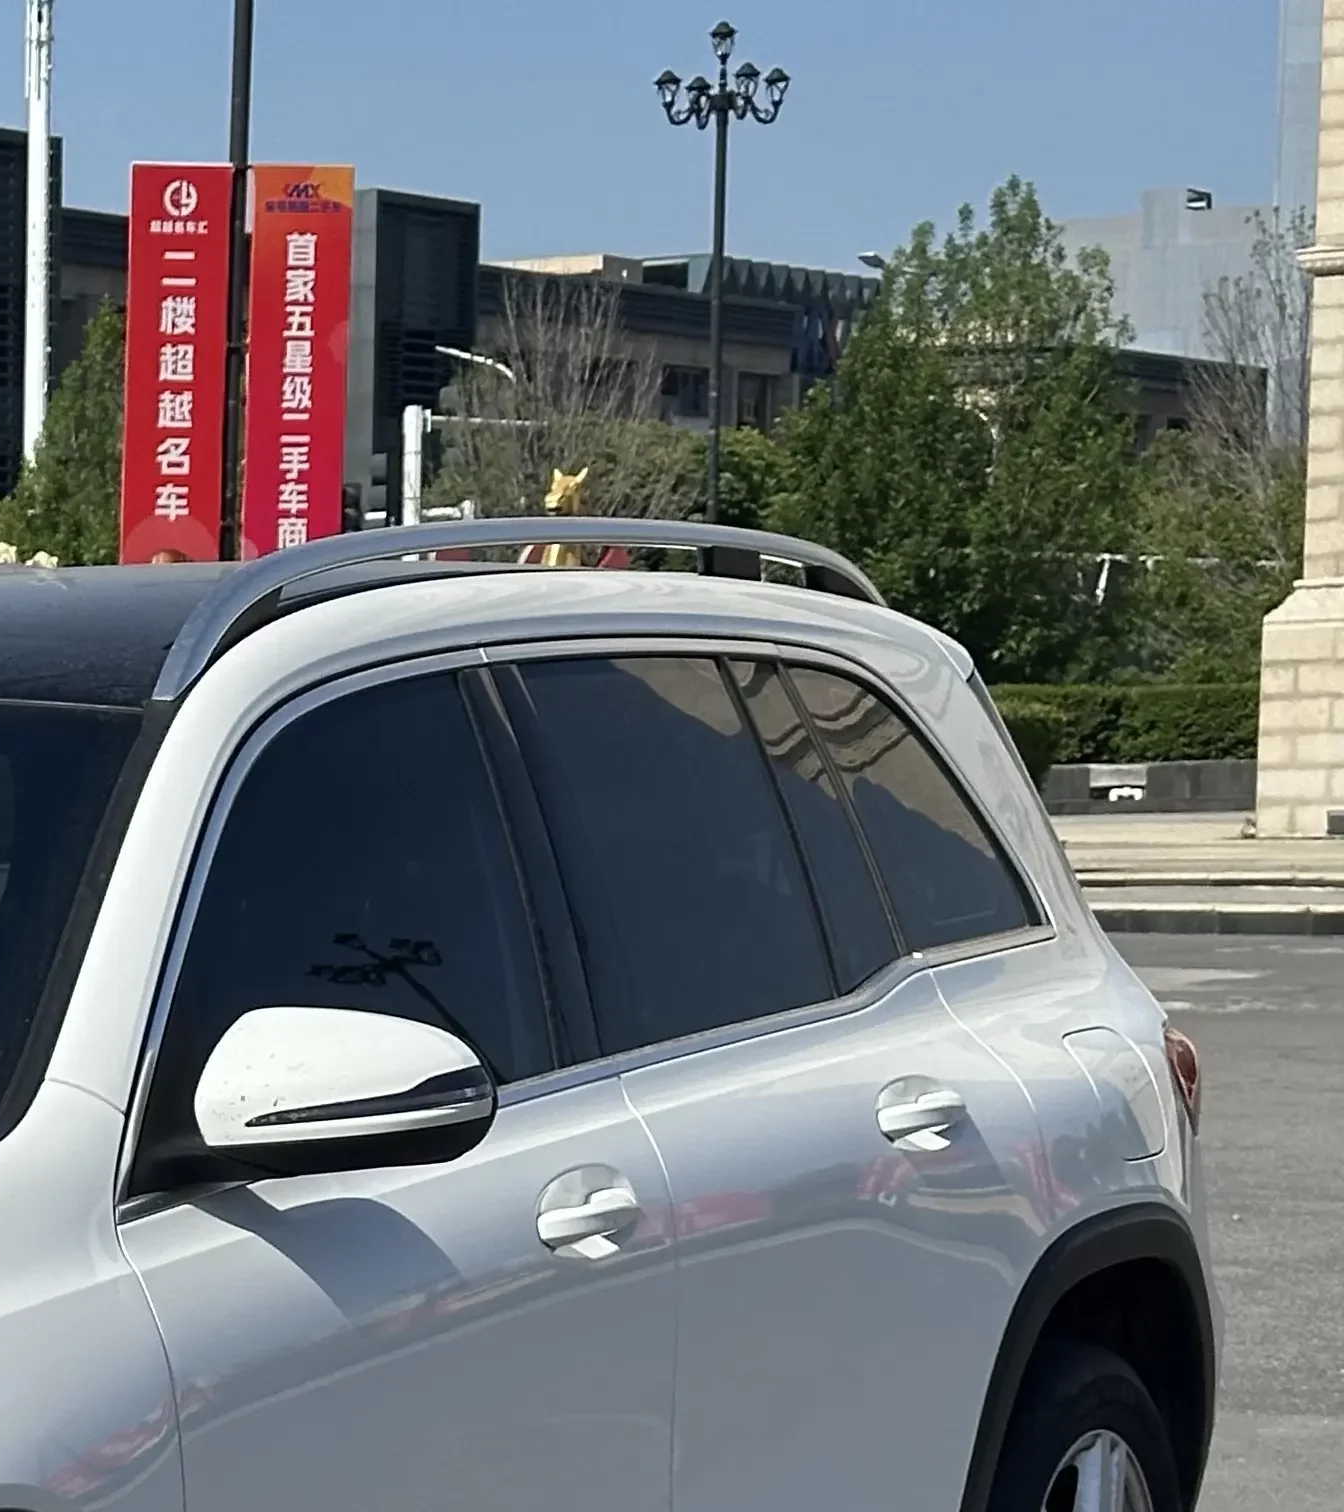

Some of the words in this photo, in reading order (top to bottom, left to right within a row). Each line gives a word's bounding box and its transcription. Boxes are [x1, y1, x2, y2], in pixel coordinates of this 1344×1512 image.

[154, 251, 197, 522] 二楼超越名车
